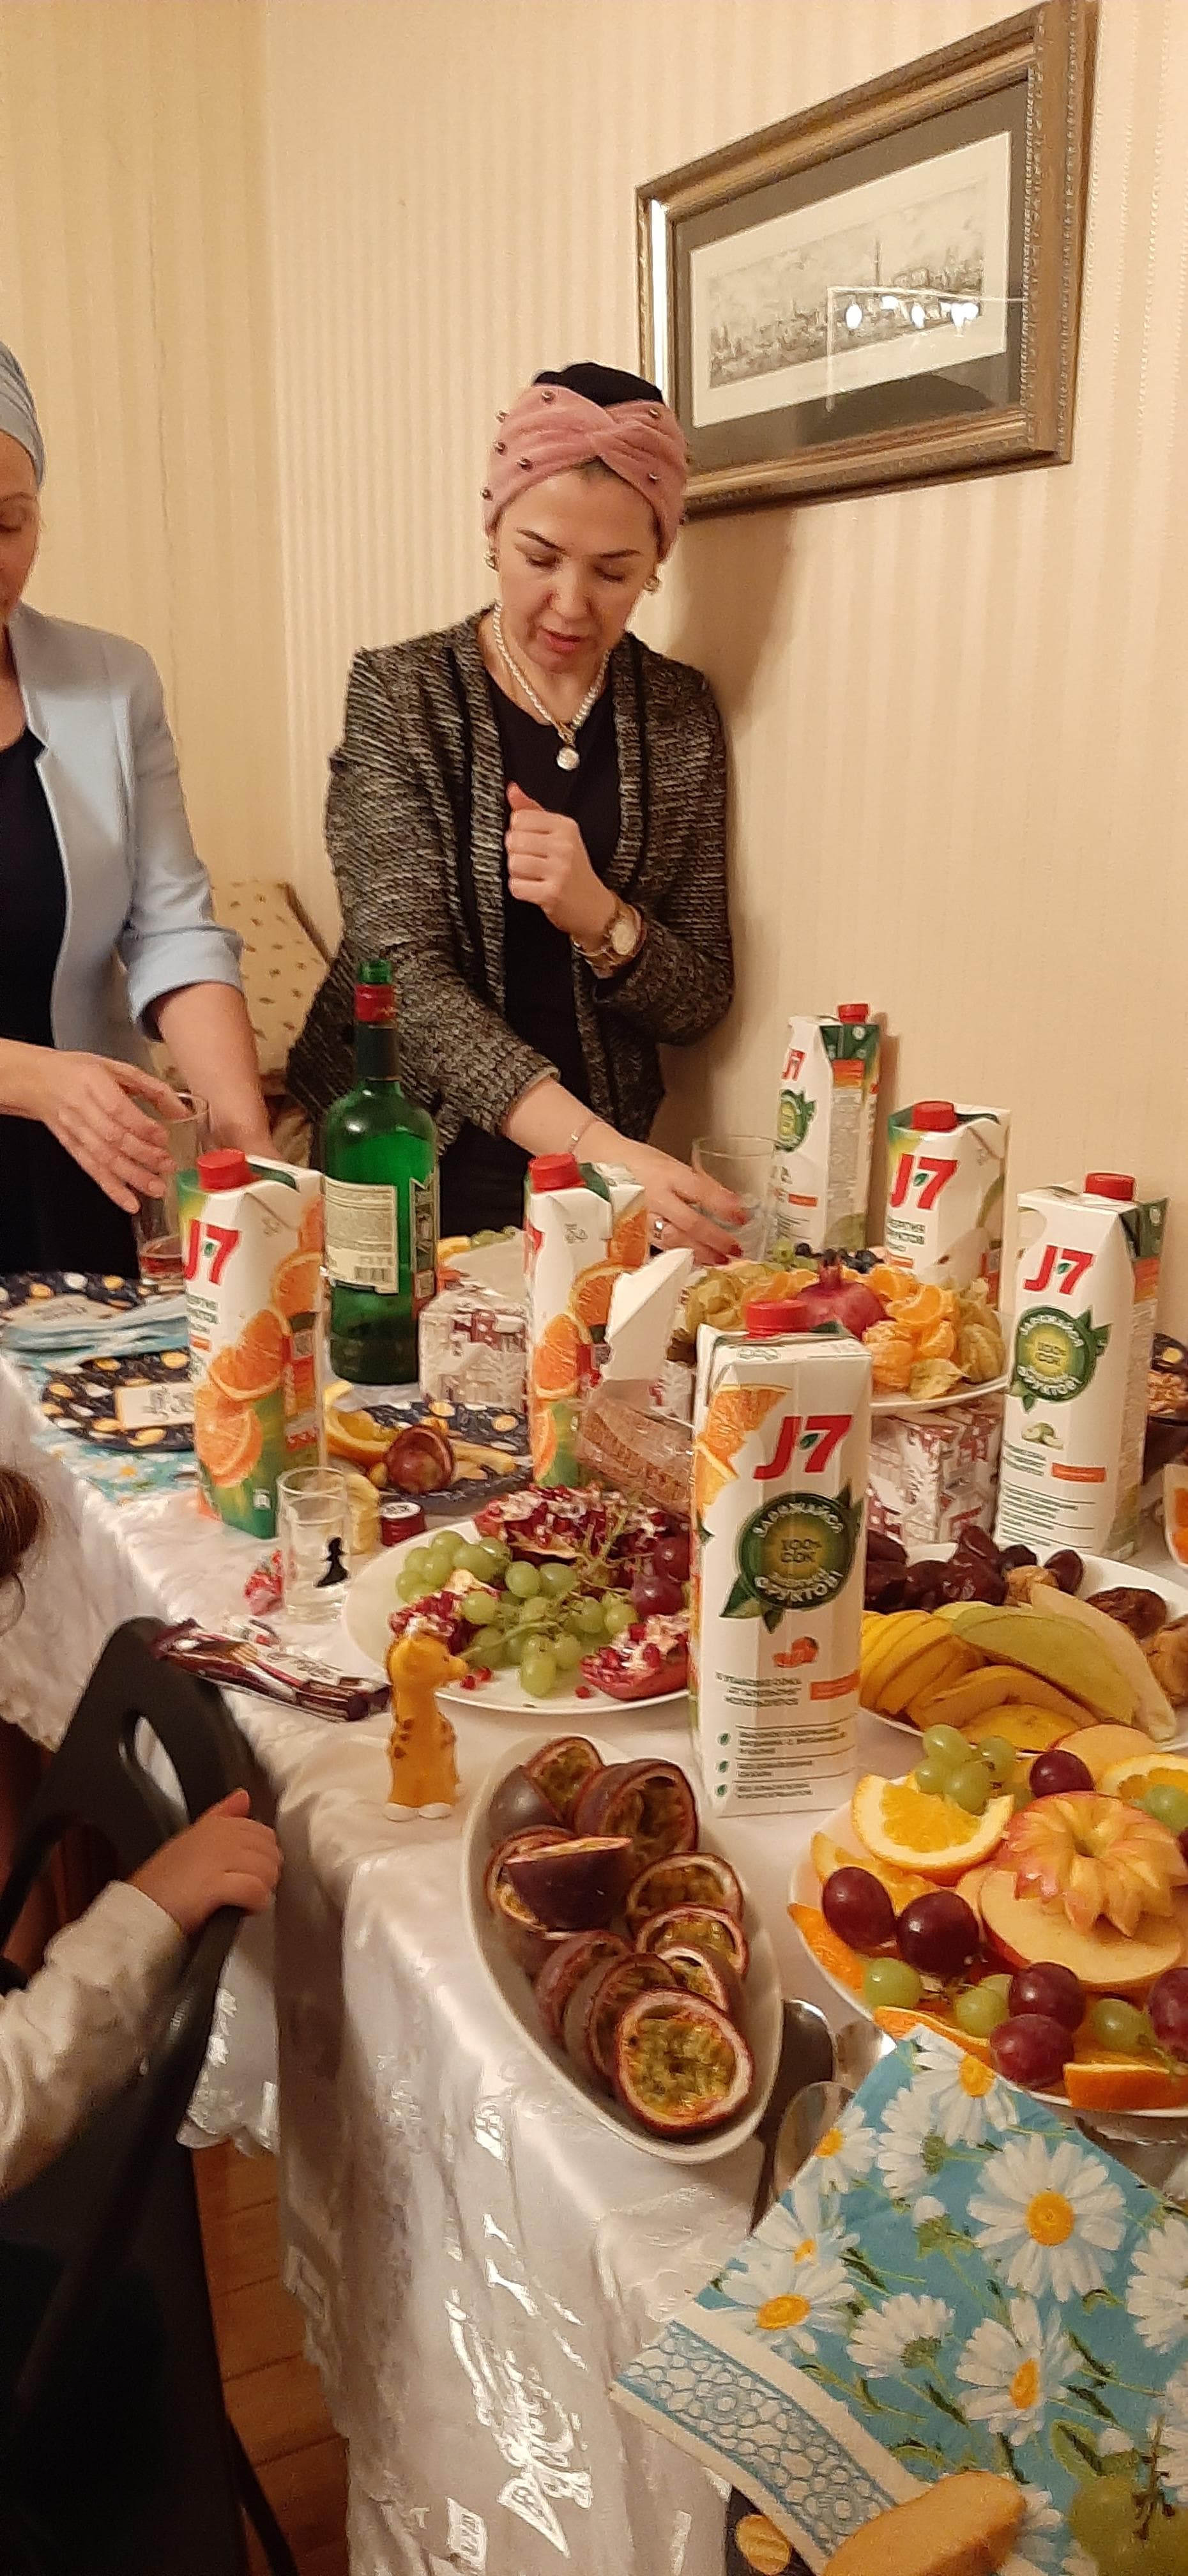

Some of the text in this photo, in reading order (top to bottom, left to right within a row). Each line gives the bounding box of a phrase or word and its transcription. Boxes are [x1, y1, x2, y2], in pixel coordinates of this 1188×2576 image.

[890, 1154, 958, 1210] J7
[183, 1219, 240, 1285] J7
[1023, 1245, 1094, 1296] J7
[752, 1414, 854, 1482] J7
